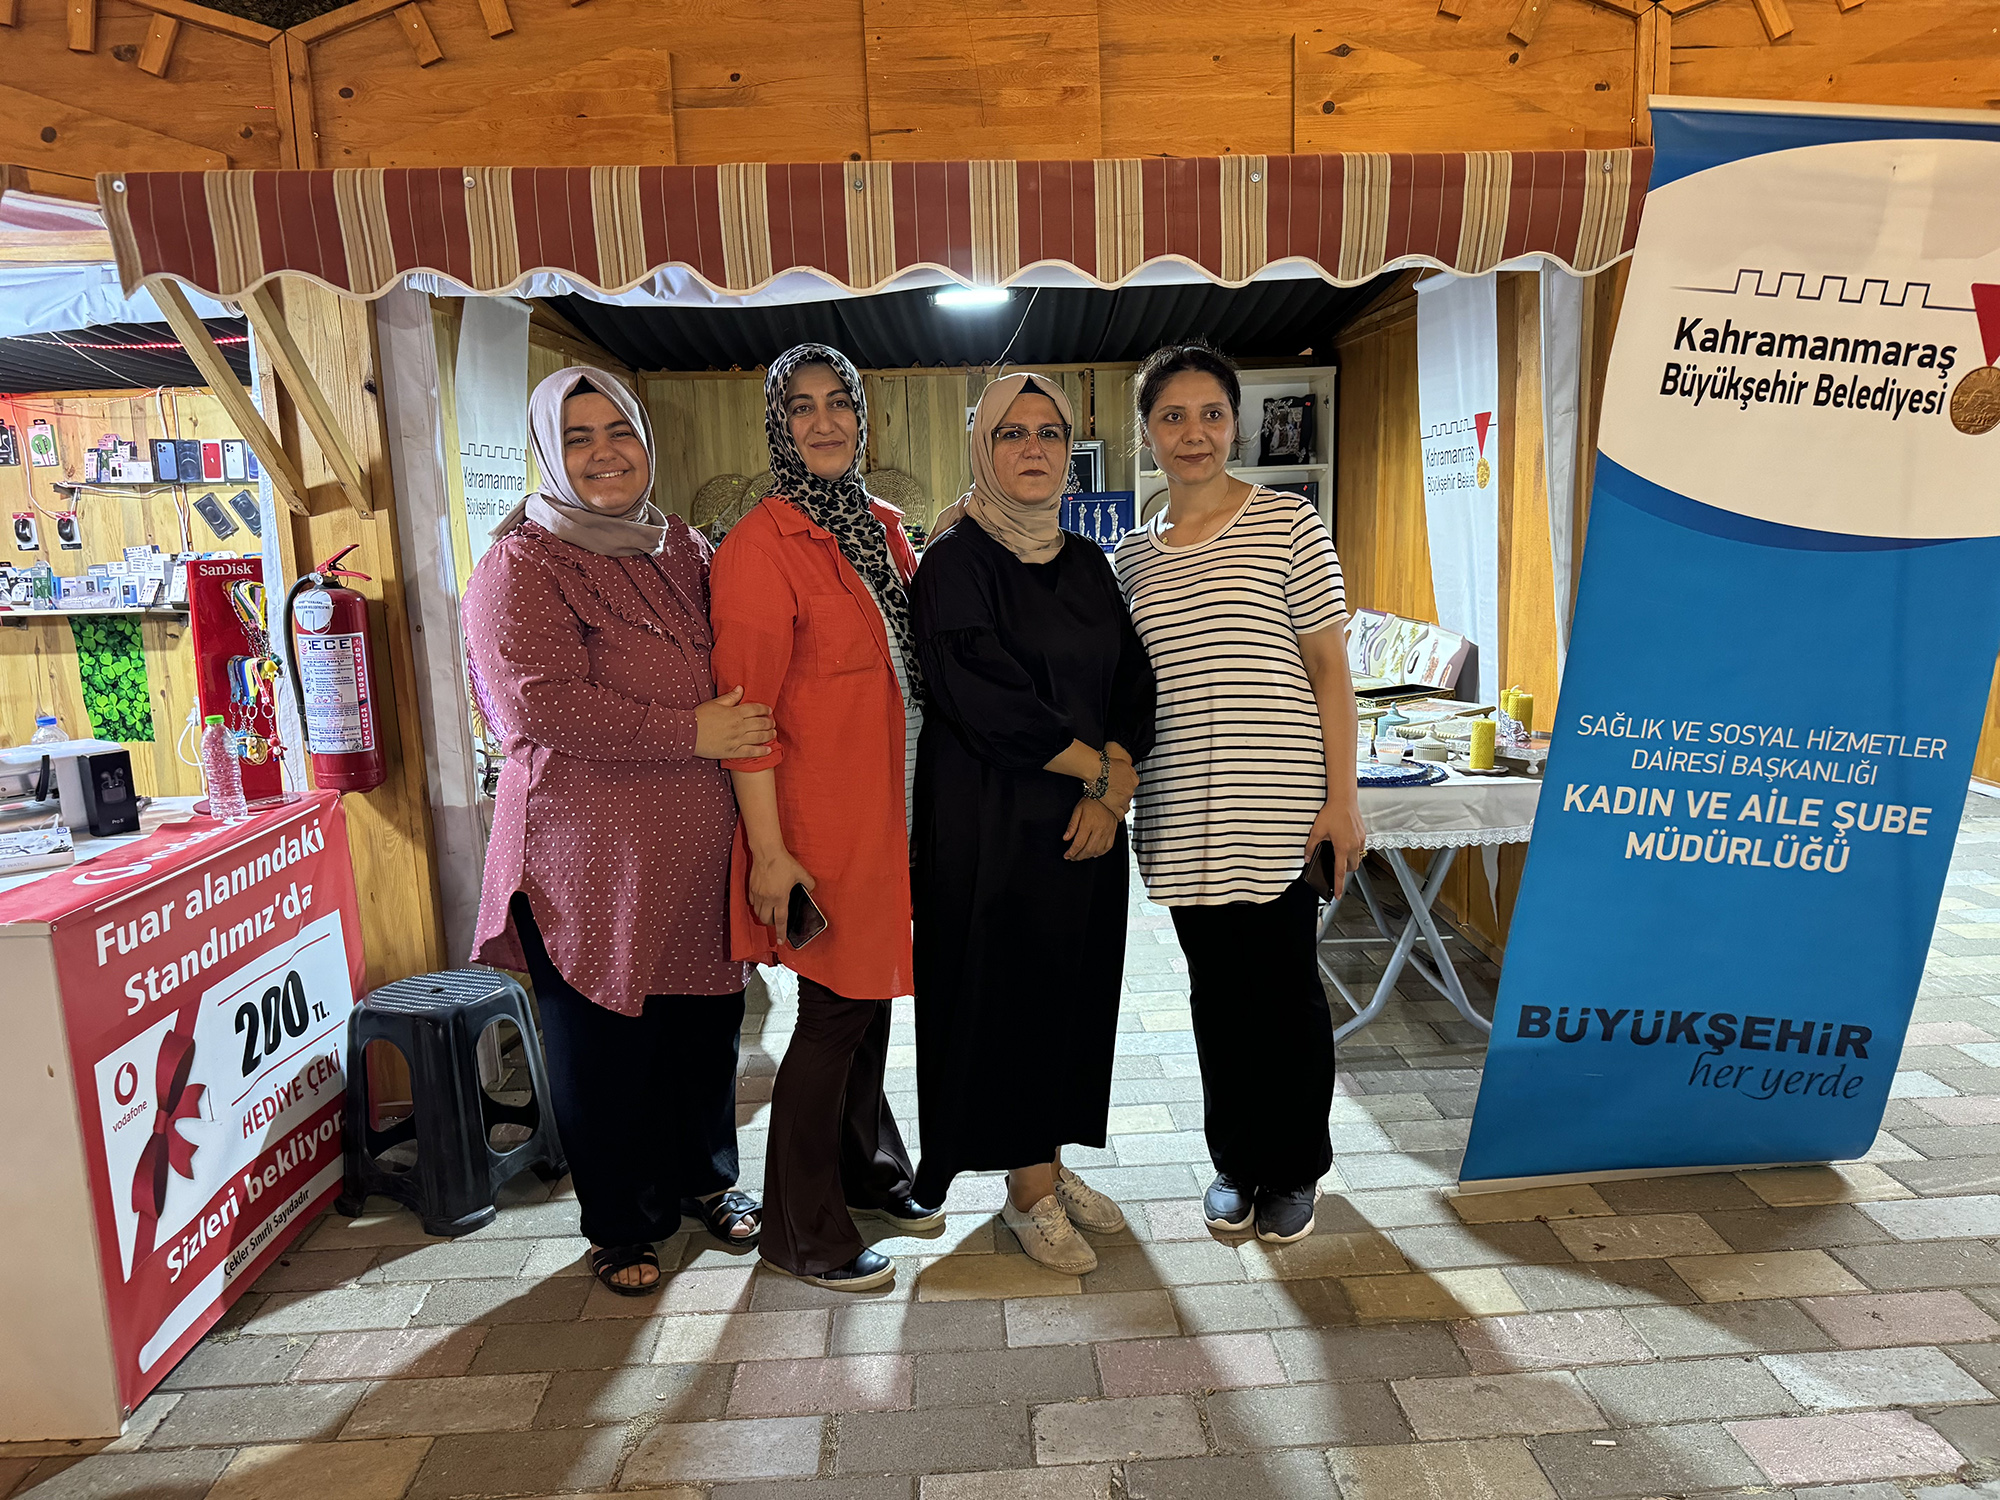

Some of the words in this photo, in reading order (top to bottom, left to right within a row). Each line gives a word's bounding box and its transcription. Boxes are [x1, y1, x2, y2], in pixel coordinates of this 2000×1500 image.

[1673, 316, 1958, 379] Kahramanmaraş
[1660, 362, 1809, 411] Büyükşehir
[1812, 373, 1949, 421] Belediyesi
[199, 562, 254, 577] SanDisk
[354, 647, 362, 663] DRY
[356, 665, 367, 699] POWDER
[1577, 711, 1666, 740] SAĞLIK
[1671, 720, 1703, 742] VE
[1707, 722, 1799, 749] SOSYAL
[1806, 725, 1948, 760] HİZMETLER
[1631, 746, 1727, 775] DAİRESİ
[1730, 755, 1878, 786] BAŞKANLIĞI
[1563, 783, 1675, 817] KADIN
[1686, 789, 1732, 820] VE
[1737, 787, 1824, 828] AİLE
[1831, 800, 1933, 837] ŞUBE
[1624, 825, 1851, 874] MÜDÜRLÜĞÜ
[95, 901, 175, 967] Fuar
[184, 818, 325, 921] alanındaki
[234, 970, 310, 1078] 200
[242, 1075, 304, 1139] HEDİYE
[306, 1042, 342, 1095] ÇEKİ
[1687, 1049, 1754, 1088] her
[1737, 1063, 1865, 1100] yerde
[112, 1099, 148, 1133] vodafone
[166, 1186, 240, 1284] Sizleri
[243, 1108, 345, 1204] bekliyor
[224, 1247, 249, 1279] Çekler
[250, 1222, 273, 1251] Sınırlı
[273, 1188, 311, 1228] Sayıdadır
